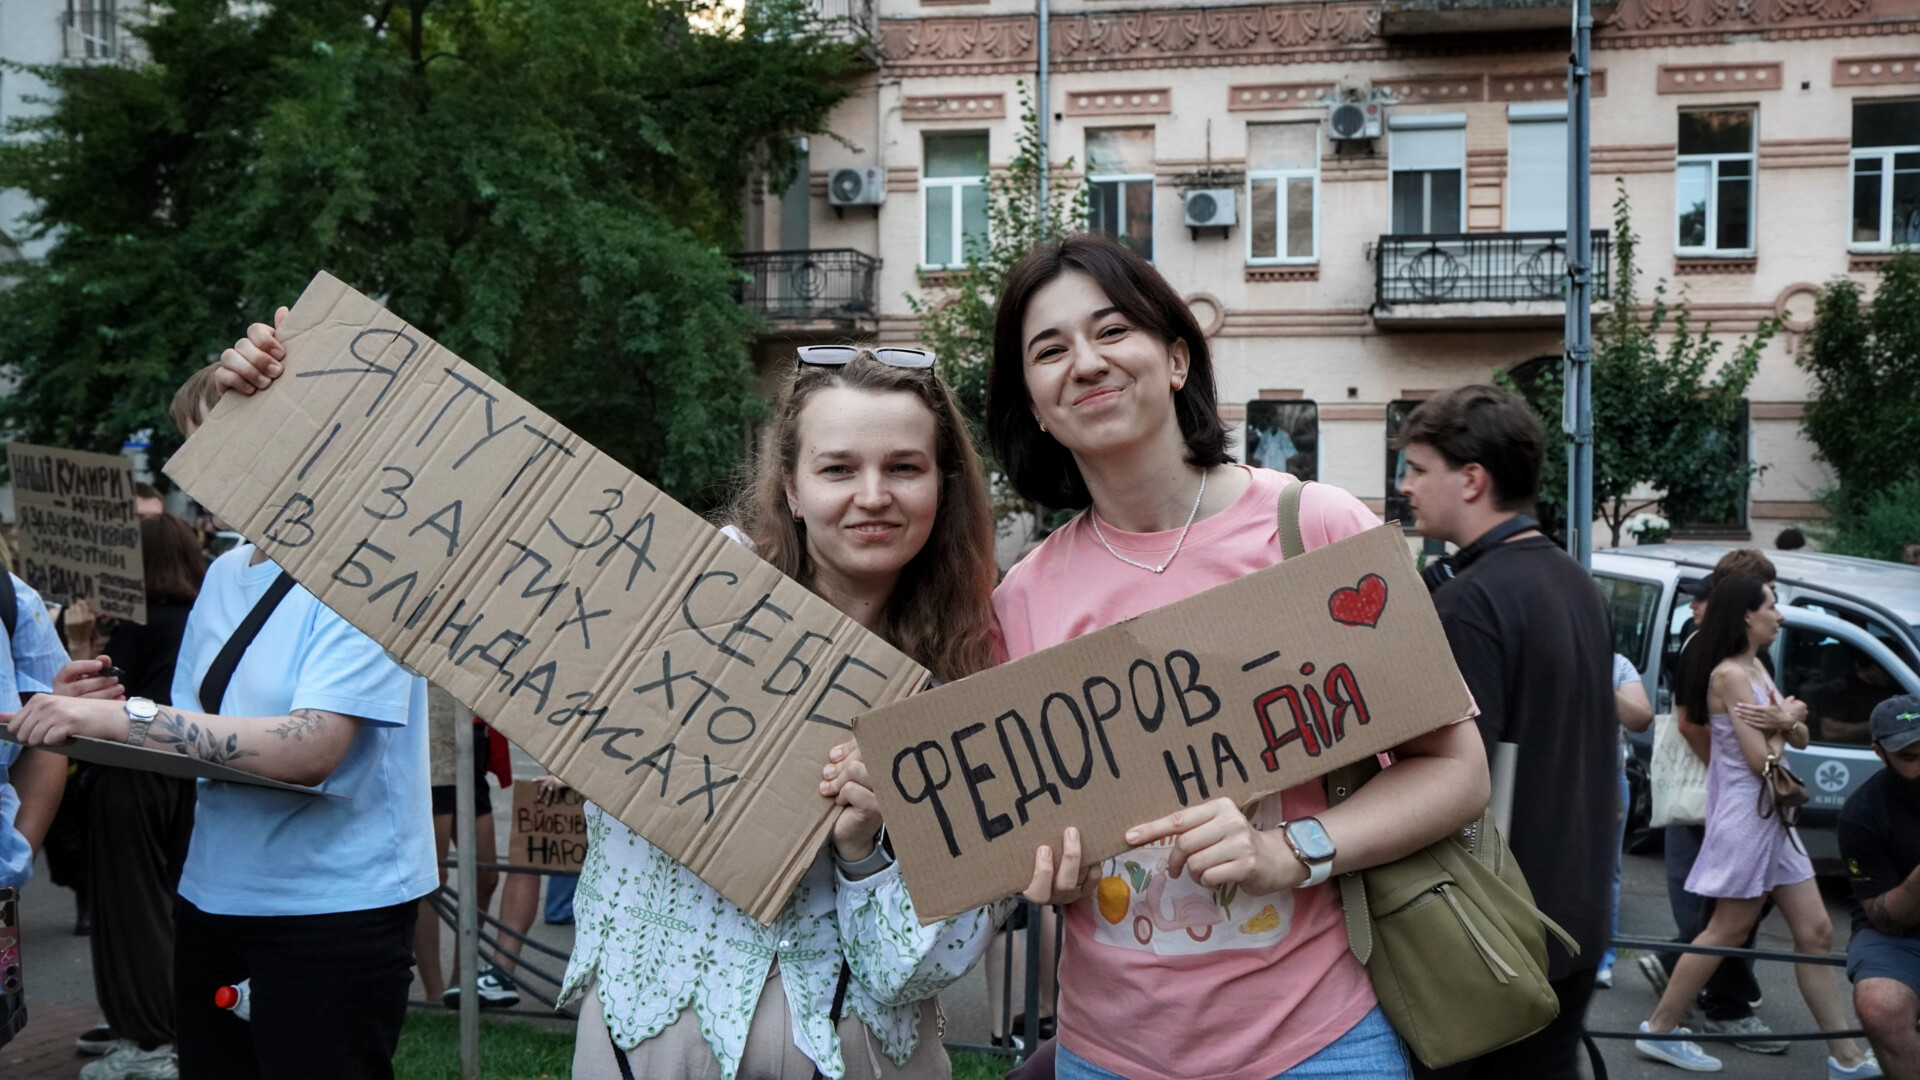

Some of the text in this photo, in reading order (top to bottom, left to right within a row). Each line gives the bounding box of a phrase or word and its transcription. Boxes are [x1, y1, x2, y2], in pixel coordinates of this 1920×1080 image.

[262, 492, 316, 548] В
[295, 328, 889, 732] Я ТУТ ЗА СЕБЕ
[361, 466, 463, 558] ЗА
[498, 538, 612, 650] ТИХ
[633, 650, 757, 745] ХТО
[892, 648, 1222, 859] ФЕДОРОВ
[1162, 732, 1249, 807] НА
[517, 806, 588, 835] ВЙОБУВ
[527, 835, 588, 866] НАРО
